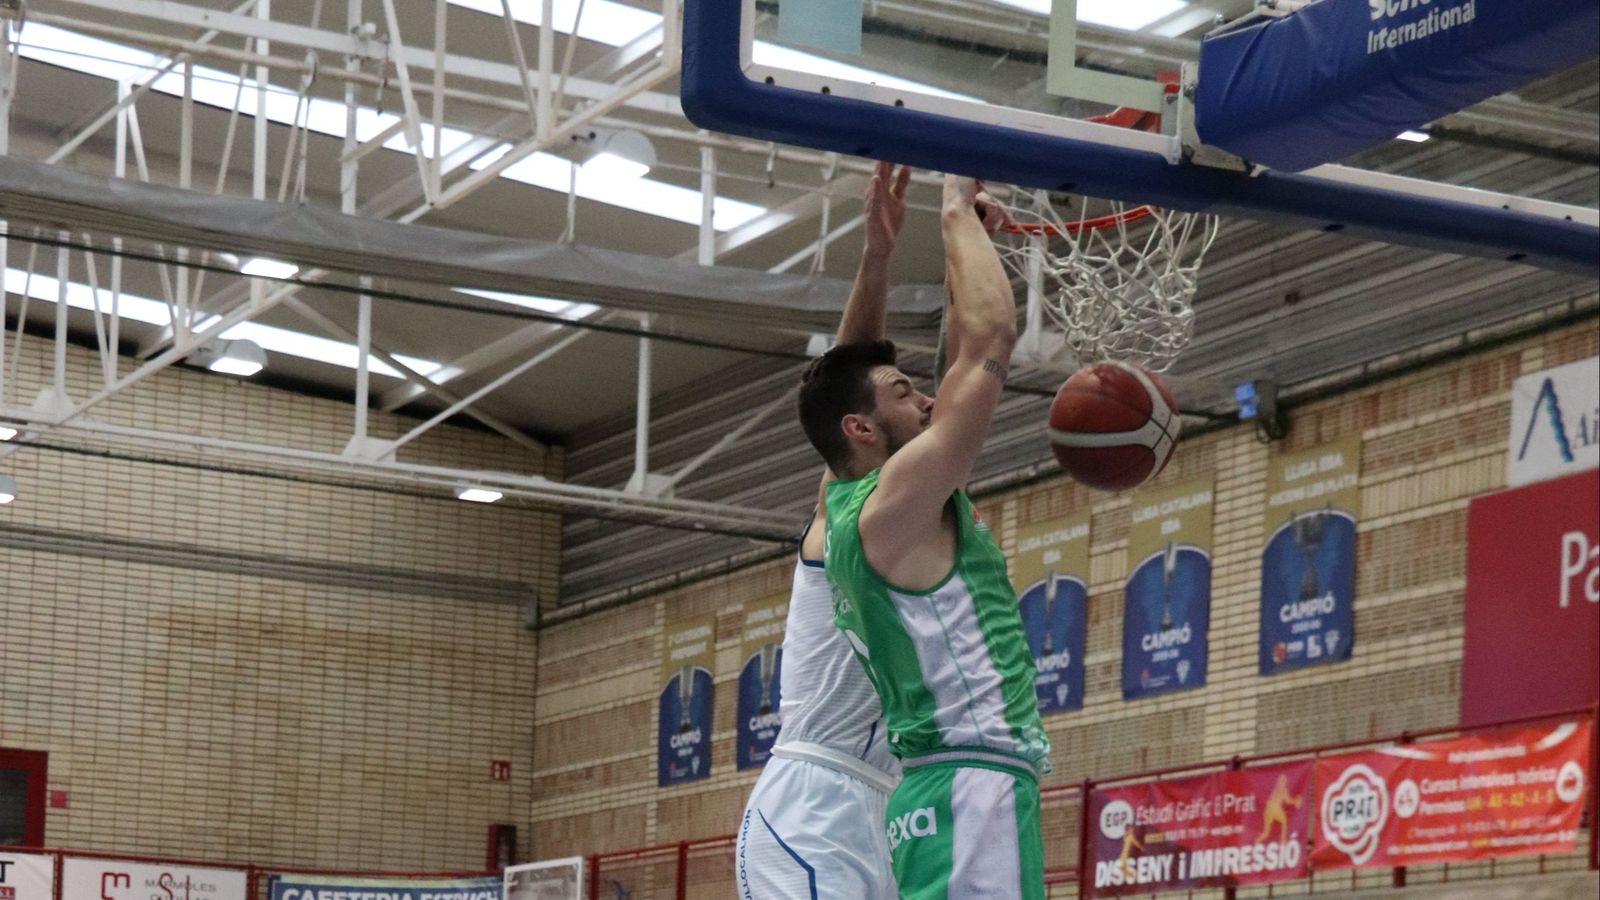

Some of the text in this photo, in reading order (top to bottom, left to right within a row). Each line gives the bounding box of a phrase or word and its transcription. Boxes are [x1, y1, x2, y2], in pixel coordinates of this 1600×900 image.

[1367, 0, 1476, 54] International
[1280, 590, 1335, 623] CAMPIÓ
[1142, 621, 1192, 652] CAMPIÓ
[1034, 647, 1070, 673] AMPIÓ
[1105, 811, 1128, 828] EGP
[1135, 801, 1174, 826] Estudi
[1223, 792, 1257, 814] Prat
[1334, 795, 1375, 822] PRAT
[887, 806, 938, 853] exa
[1095, 853, 1174, 888] DISSENY
